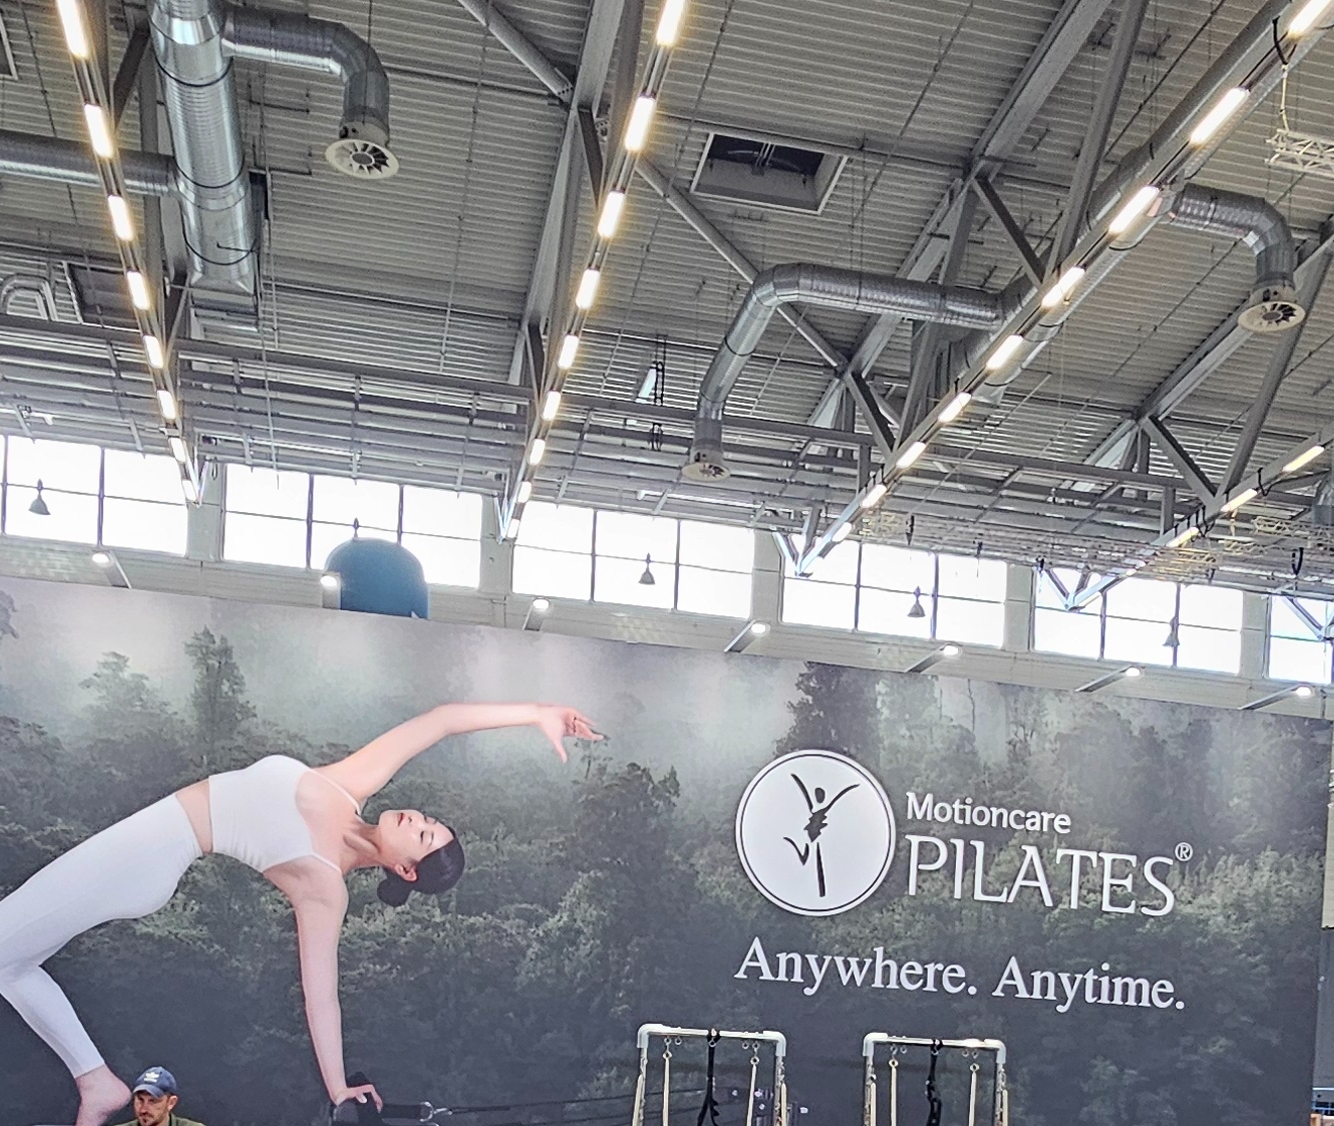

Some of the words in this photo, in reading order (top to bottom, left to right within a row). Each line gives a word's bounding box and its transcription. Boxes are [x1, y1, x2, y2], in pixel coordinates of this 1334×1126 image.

[906, 791, 1072, 834] Motioncare
[734, 936, 978, 996] Anywhere.
[992, 956, 1186, 1013] Anytime.
